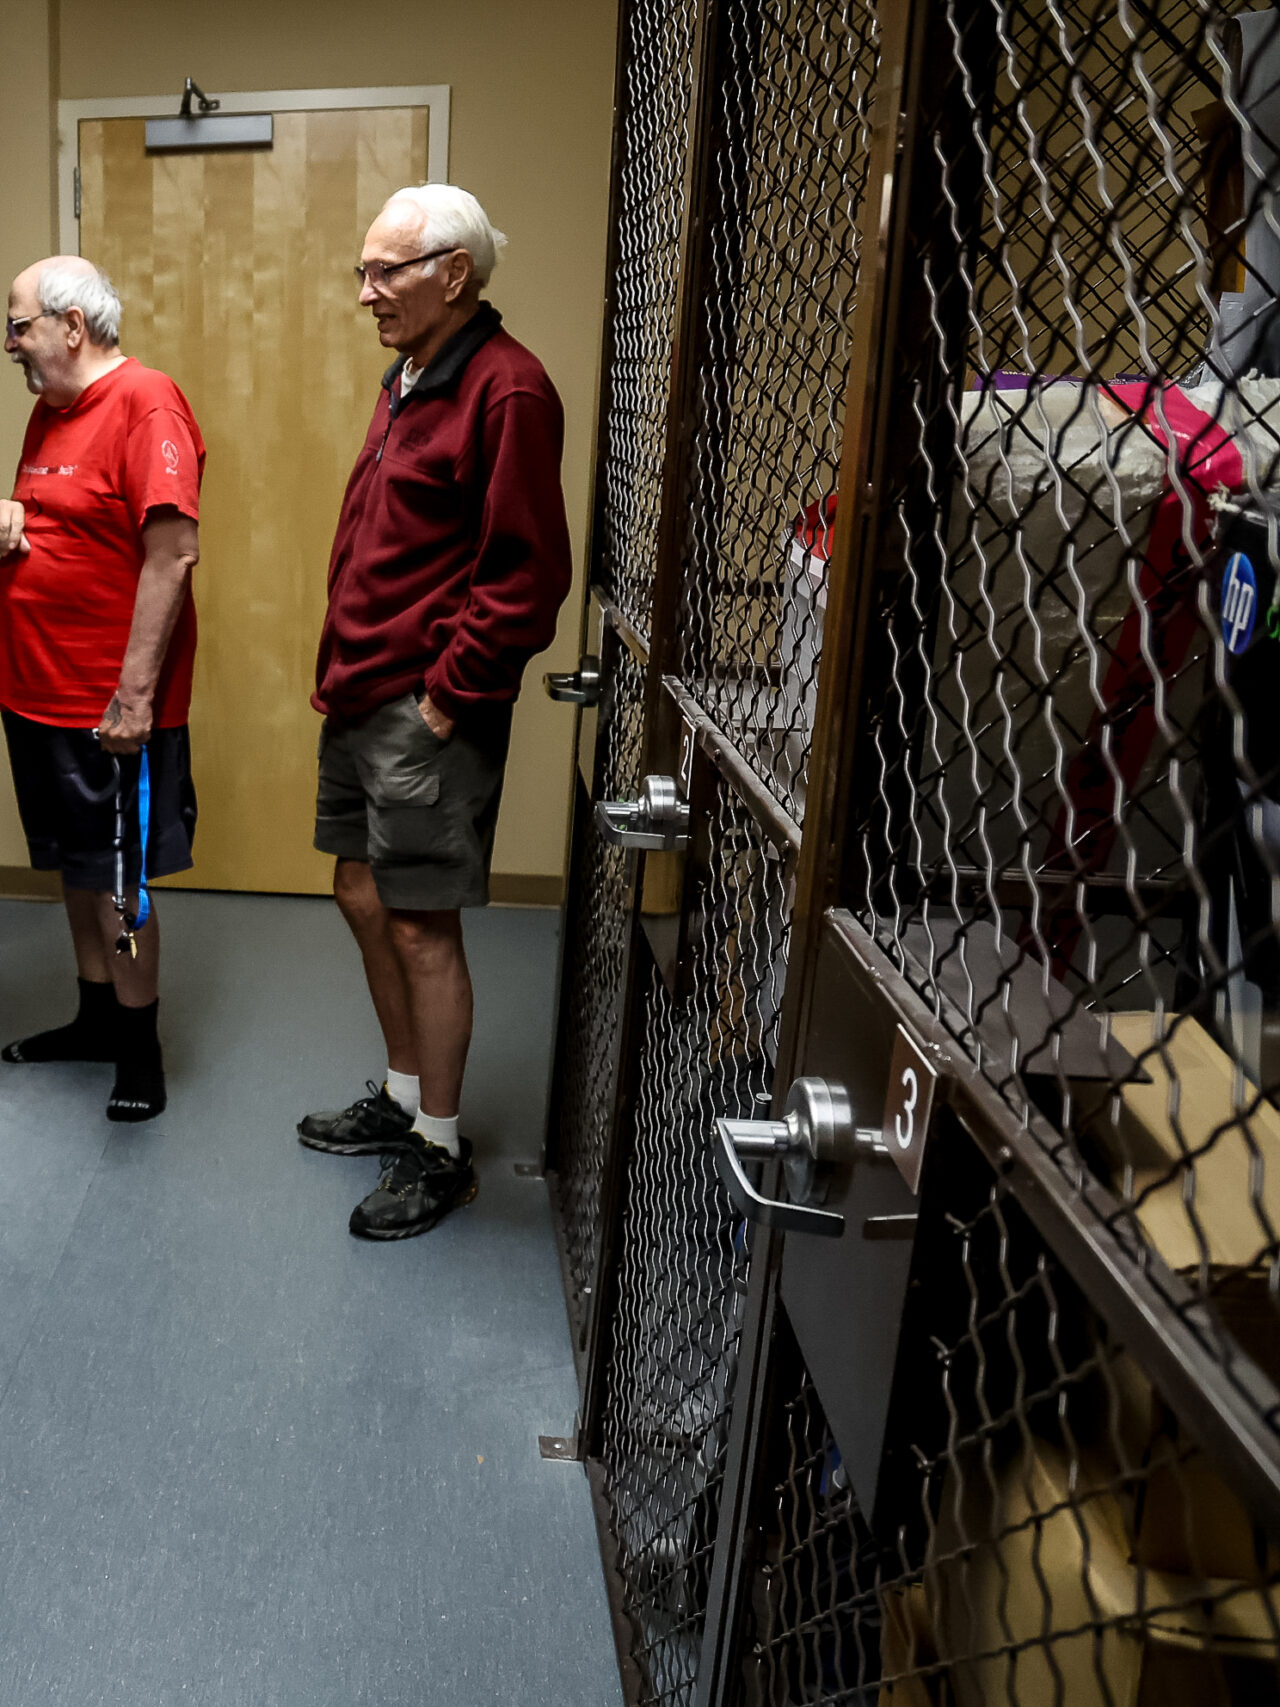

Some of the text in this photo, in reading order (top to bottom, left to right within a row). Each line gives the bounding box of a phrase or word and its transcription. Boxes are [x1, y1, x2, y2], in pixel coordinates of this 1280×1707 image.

[1223, 552, 1255, 652] hp
[680, 734, 689, 782] 2
[895, 1067, 918, 1150] 3
